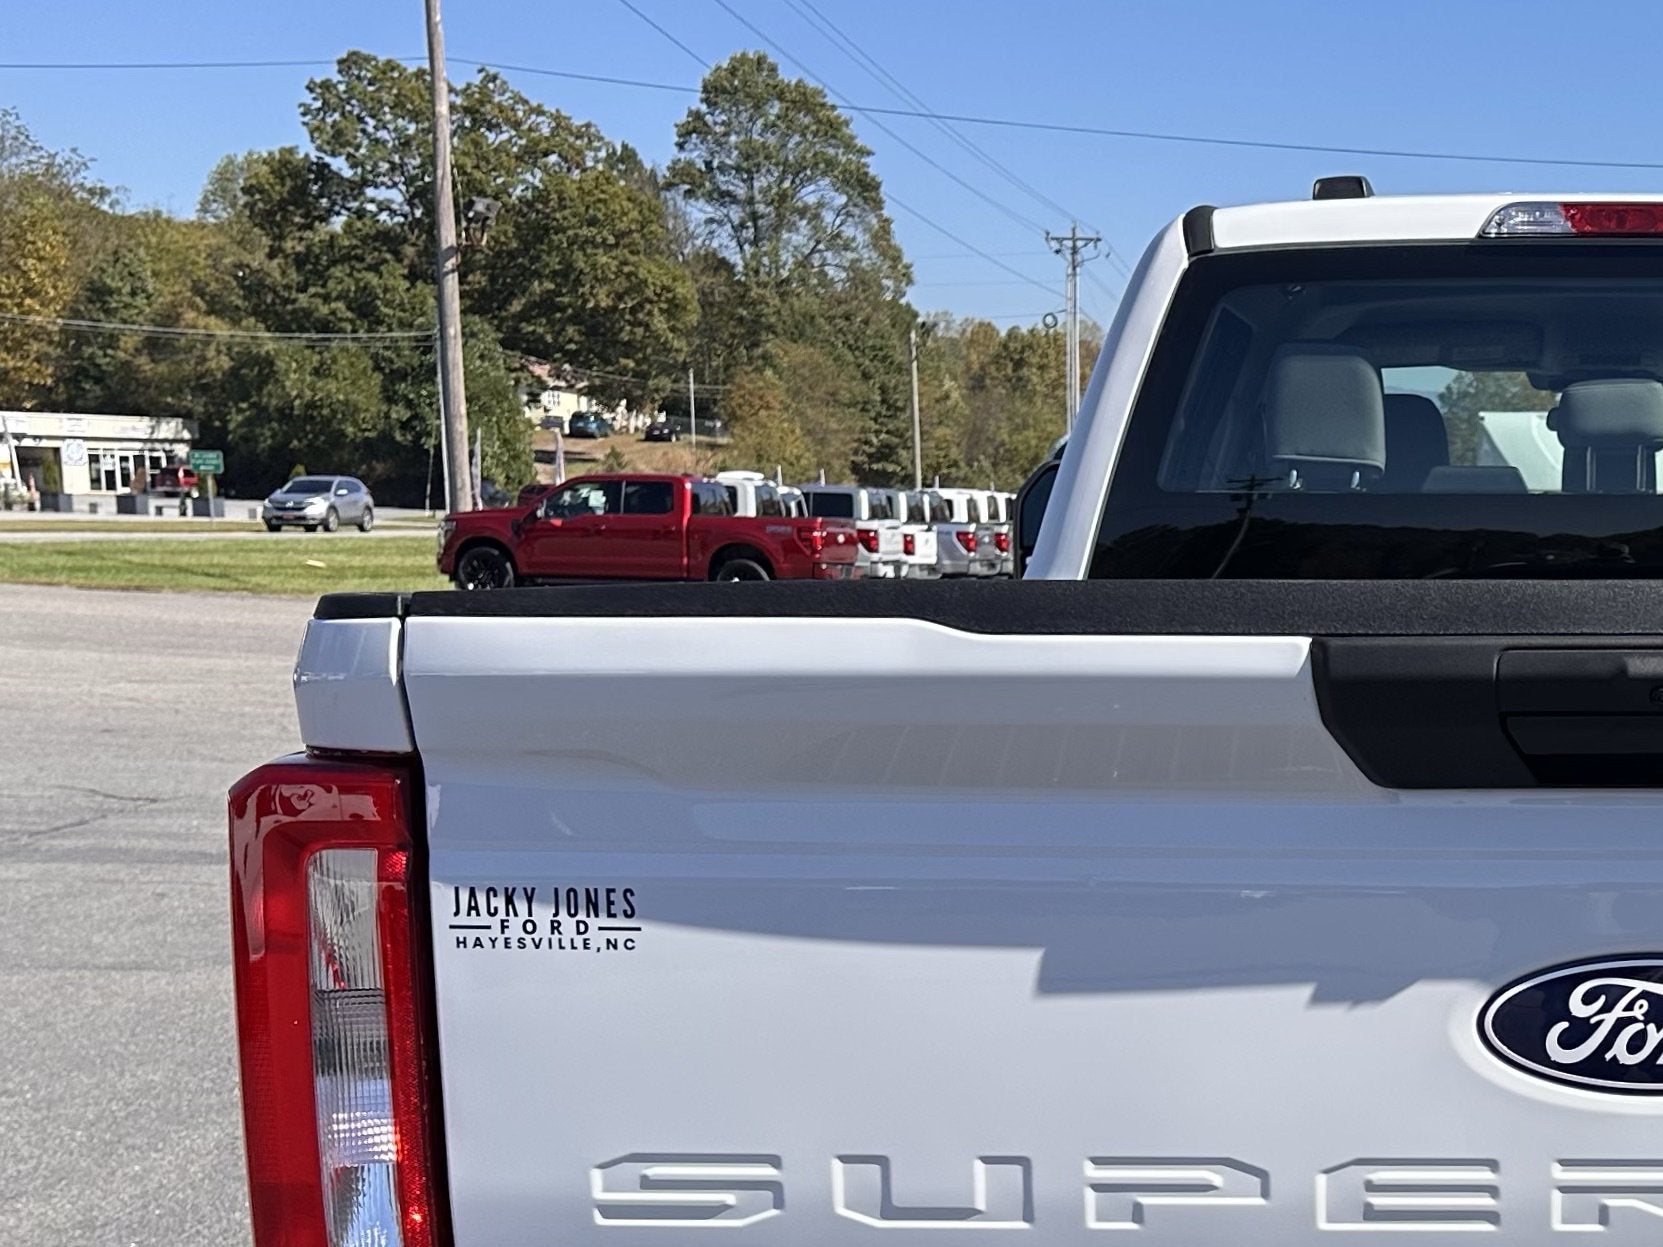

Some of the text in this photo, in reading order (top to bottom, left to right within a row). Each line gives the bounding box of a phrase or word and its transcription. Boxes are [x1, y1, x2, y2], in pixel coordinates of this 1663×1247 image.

[453, 886, 636, 919] JACKY JONES
[500, 918, 590, 936] FORD
